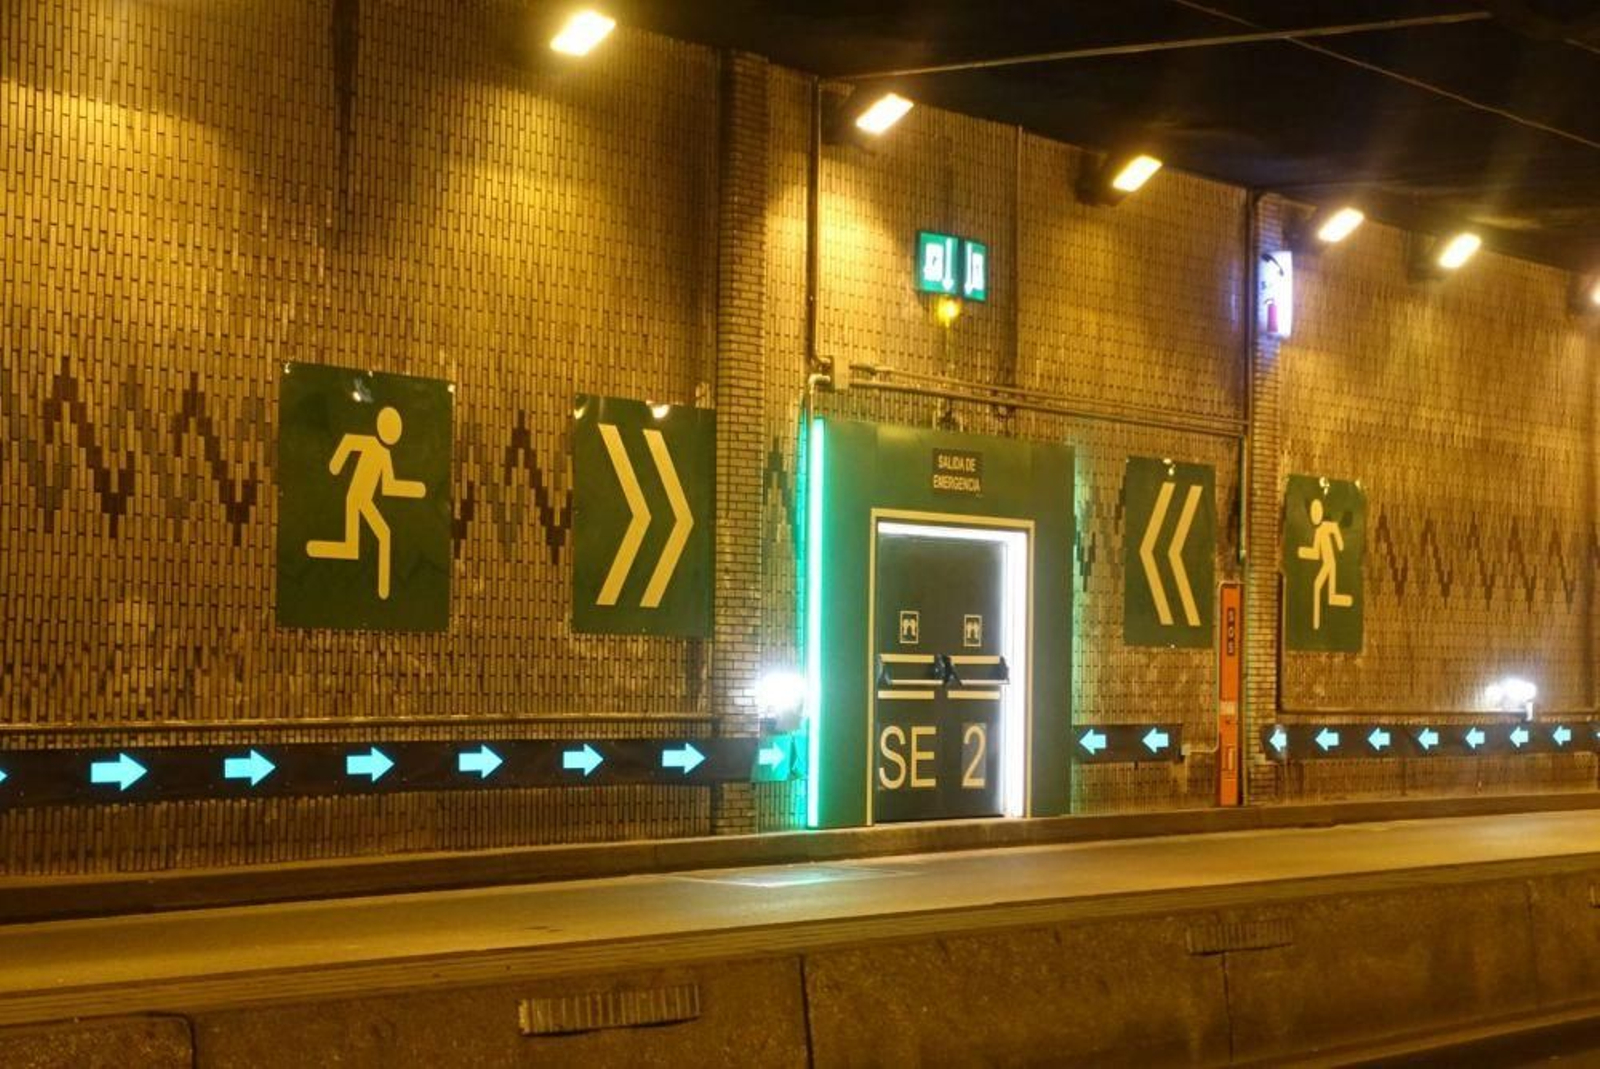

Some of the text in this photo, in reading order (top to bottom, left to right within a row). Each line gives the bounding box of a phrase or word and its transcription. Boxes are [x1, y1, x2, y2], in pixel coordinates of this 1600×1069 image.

[938, 454, 976, 472] SALIDA DE
[933, 474, 981, 492] EMERGENCIA
[1227, 609, 1235, 654] SOS
[879, 725, 986, 789] SE 2
